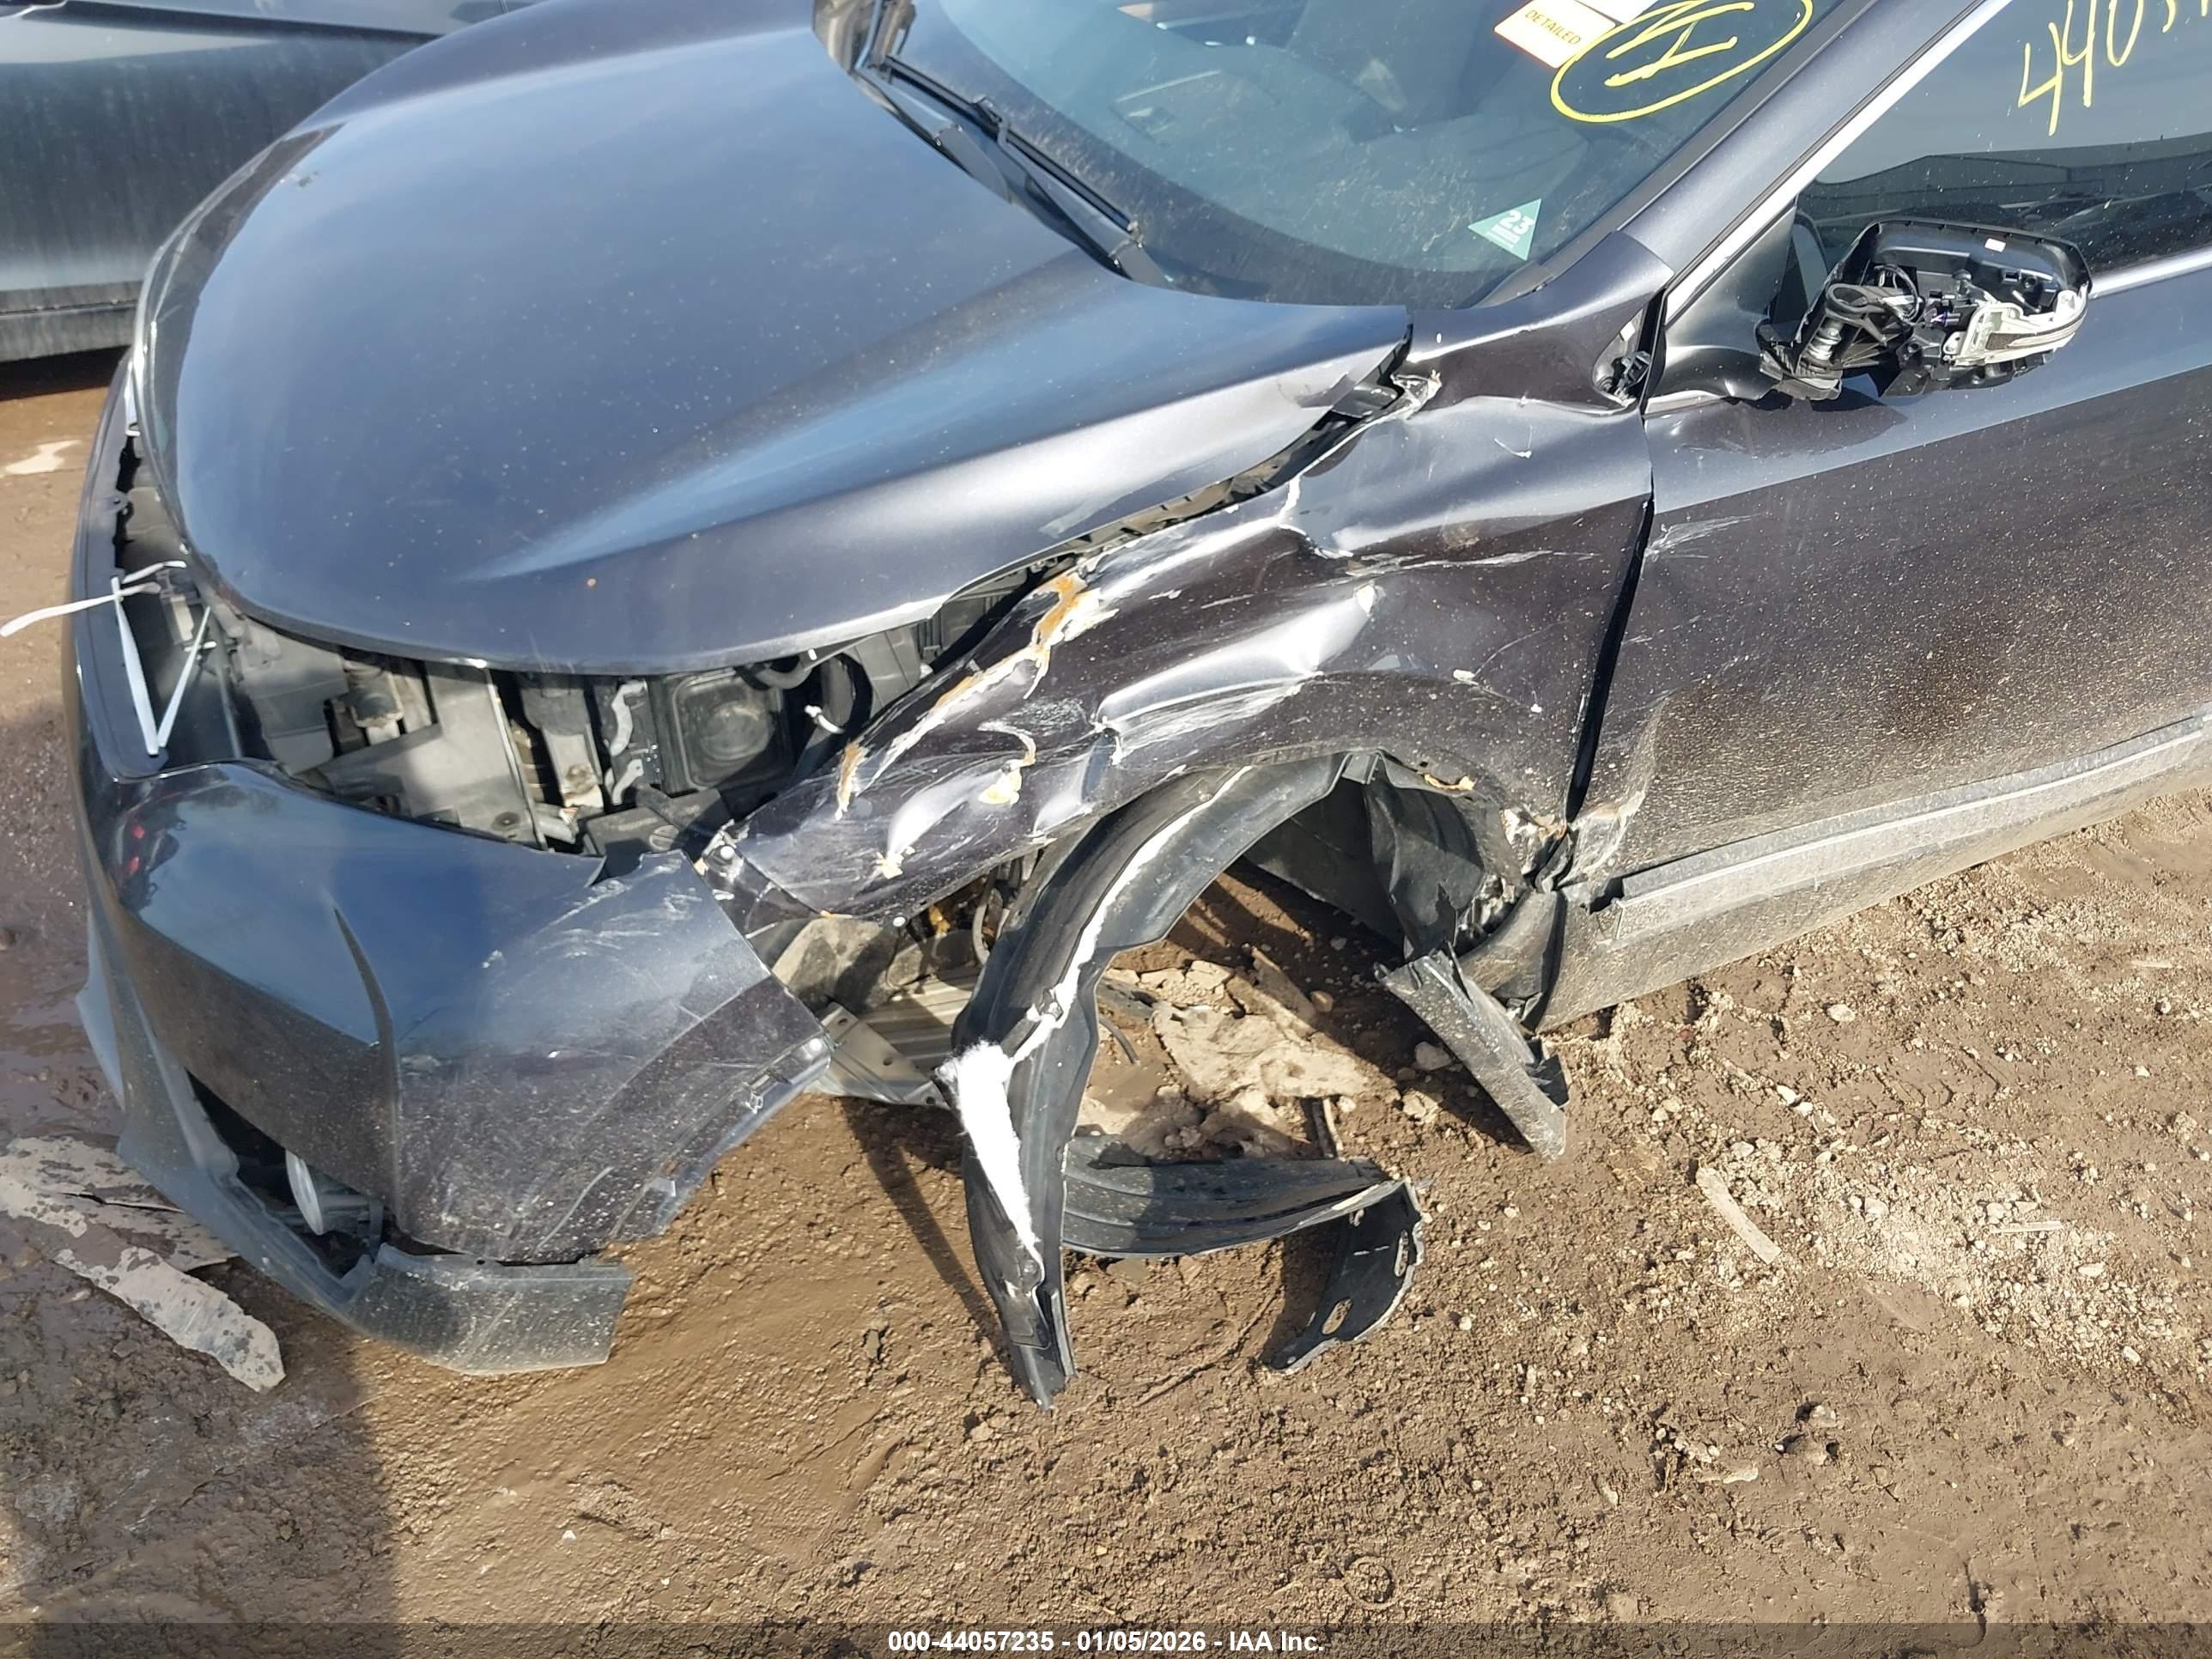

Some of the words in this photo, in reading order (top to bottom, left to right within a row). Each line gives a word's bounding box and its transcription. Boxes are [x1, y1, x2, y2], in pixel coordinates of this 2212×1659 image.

[1524, 9, 1582, 46] DETAILED
[2017, 0, 2210, 137] 440
[1498, 209, 1534, 235] 23
